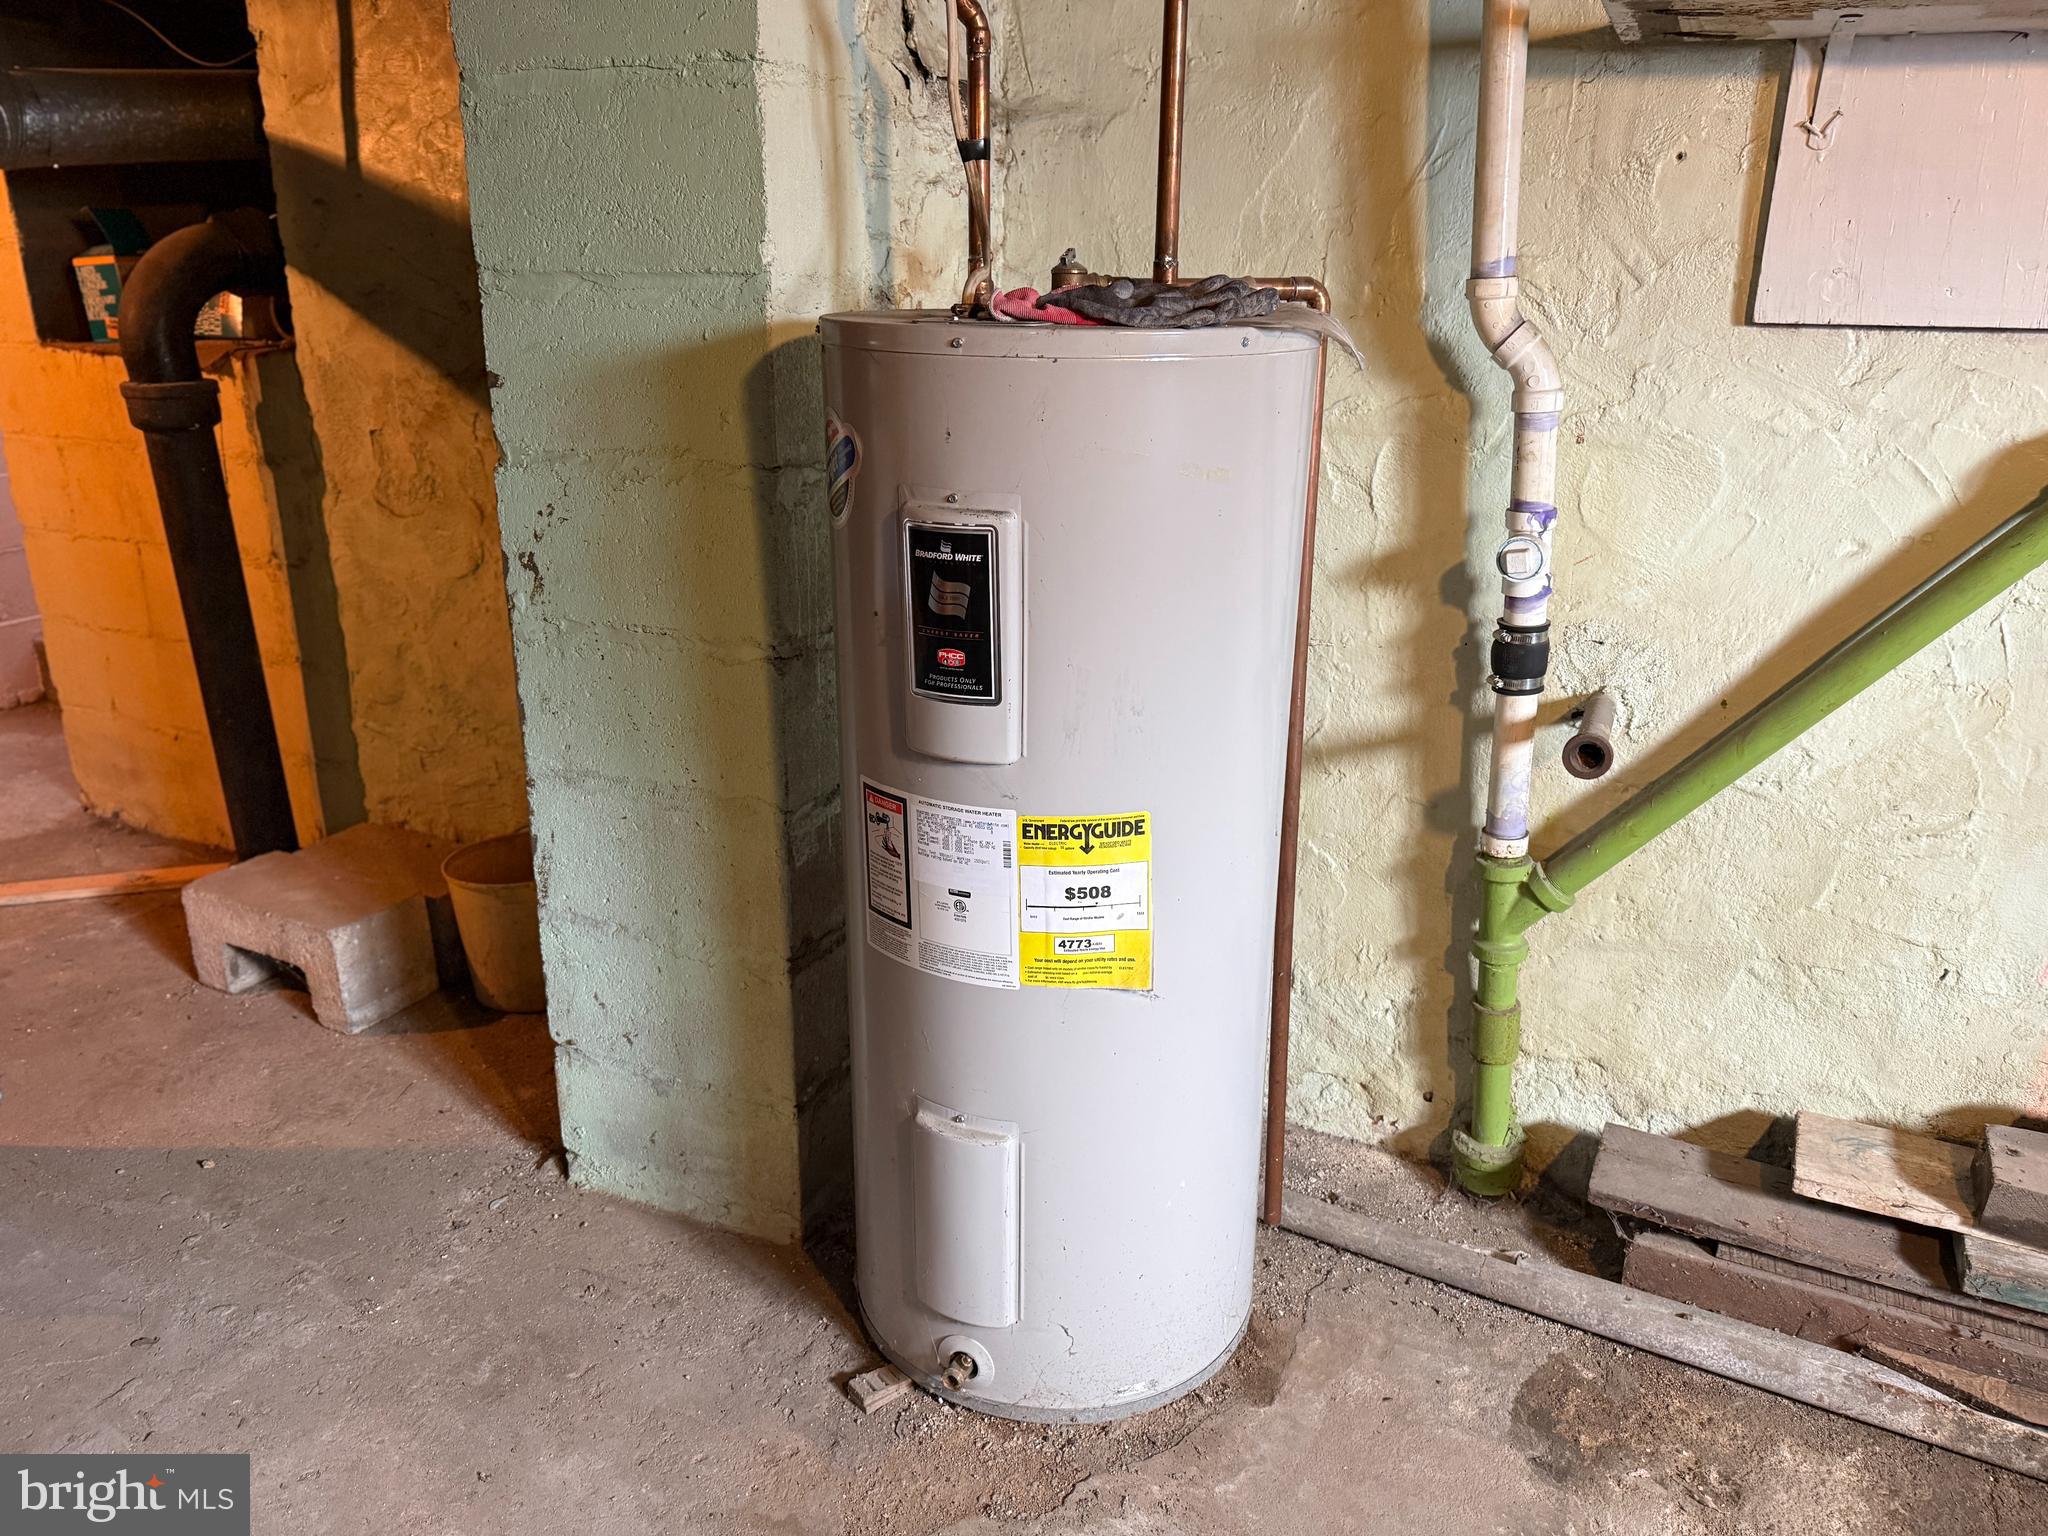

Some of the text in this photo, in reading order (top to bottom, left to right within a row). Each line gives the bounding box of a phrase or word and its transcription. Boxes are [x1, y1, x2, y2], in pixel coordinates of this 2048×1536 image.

[915, 549, 983, 562] BRADFORD WHITE
[938, 652, 964, 660] PHCC
[929, 673, 976, 685] PRODUCTS ONLY
[936, 681, 983, 691] PROFESSIONALS
[918, 800, 941, 809] AUTOMATIC
[942, 805, 964, 813] STORAGE
[1022, 819, 1145, 843] ENERGYGUIDE
[1065, 885, 1111, 902] $508
[1058, 939, 1091, 949] 4773
